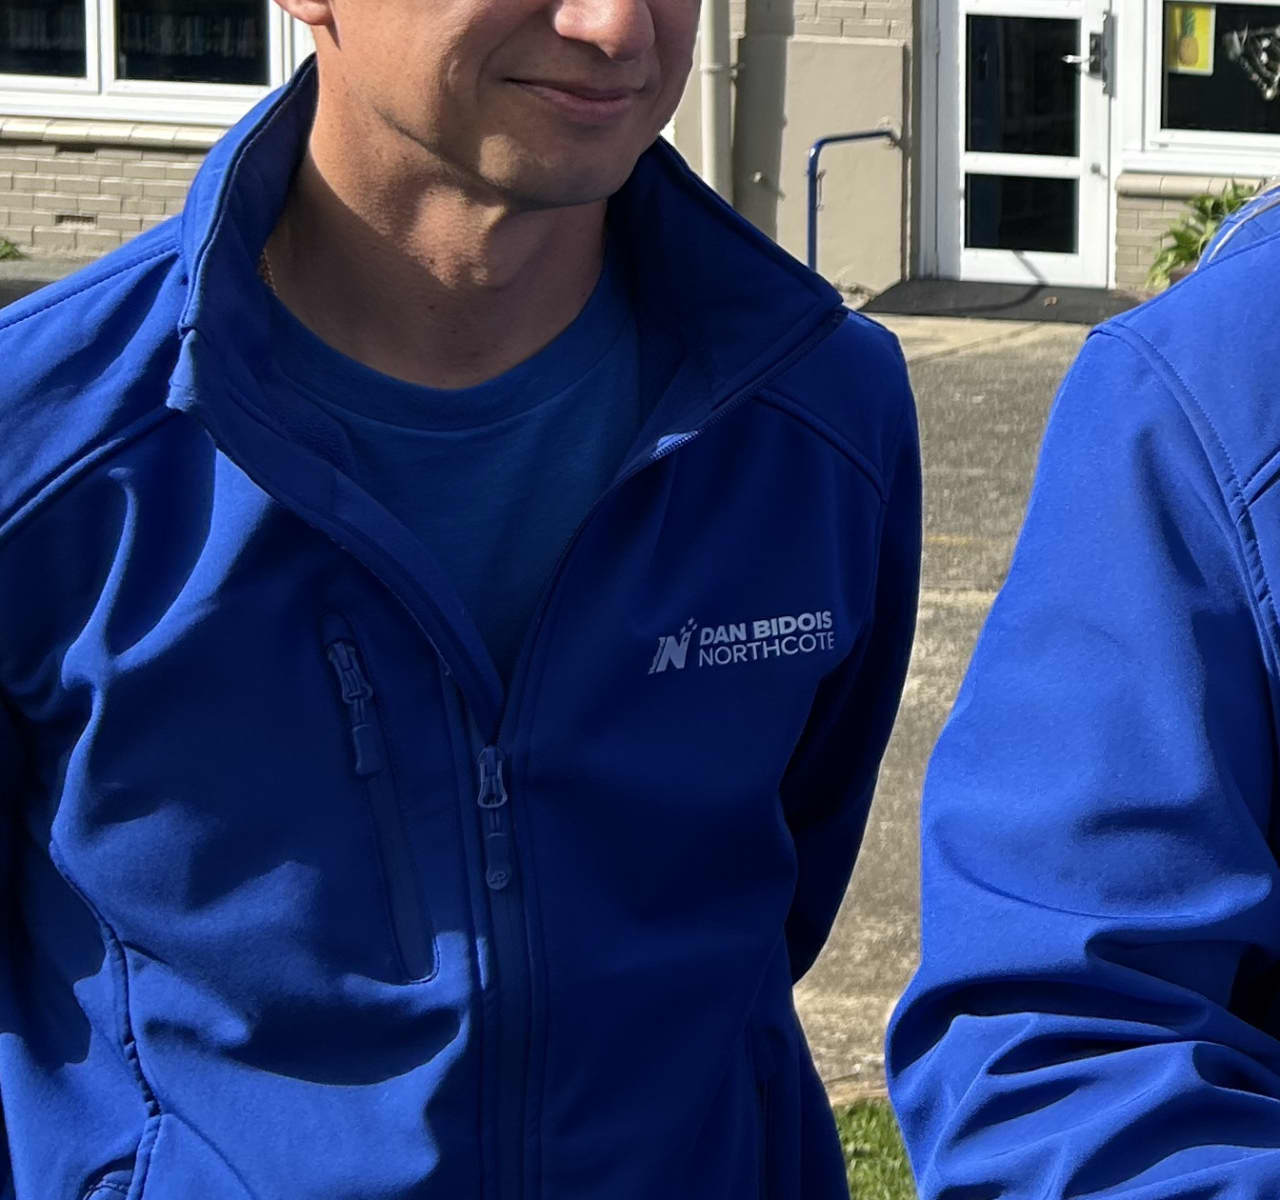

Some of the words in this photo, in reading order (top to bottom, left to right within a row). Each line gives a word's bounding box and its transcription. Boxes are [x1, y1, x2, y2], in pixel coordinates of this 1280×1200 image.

[700, 623, 747, 645] DAN
[753, 611, 832, 640] BIDOIS
[699, 632, 834, 667] NORTHCOTE
